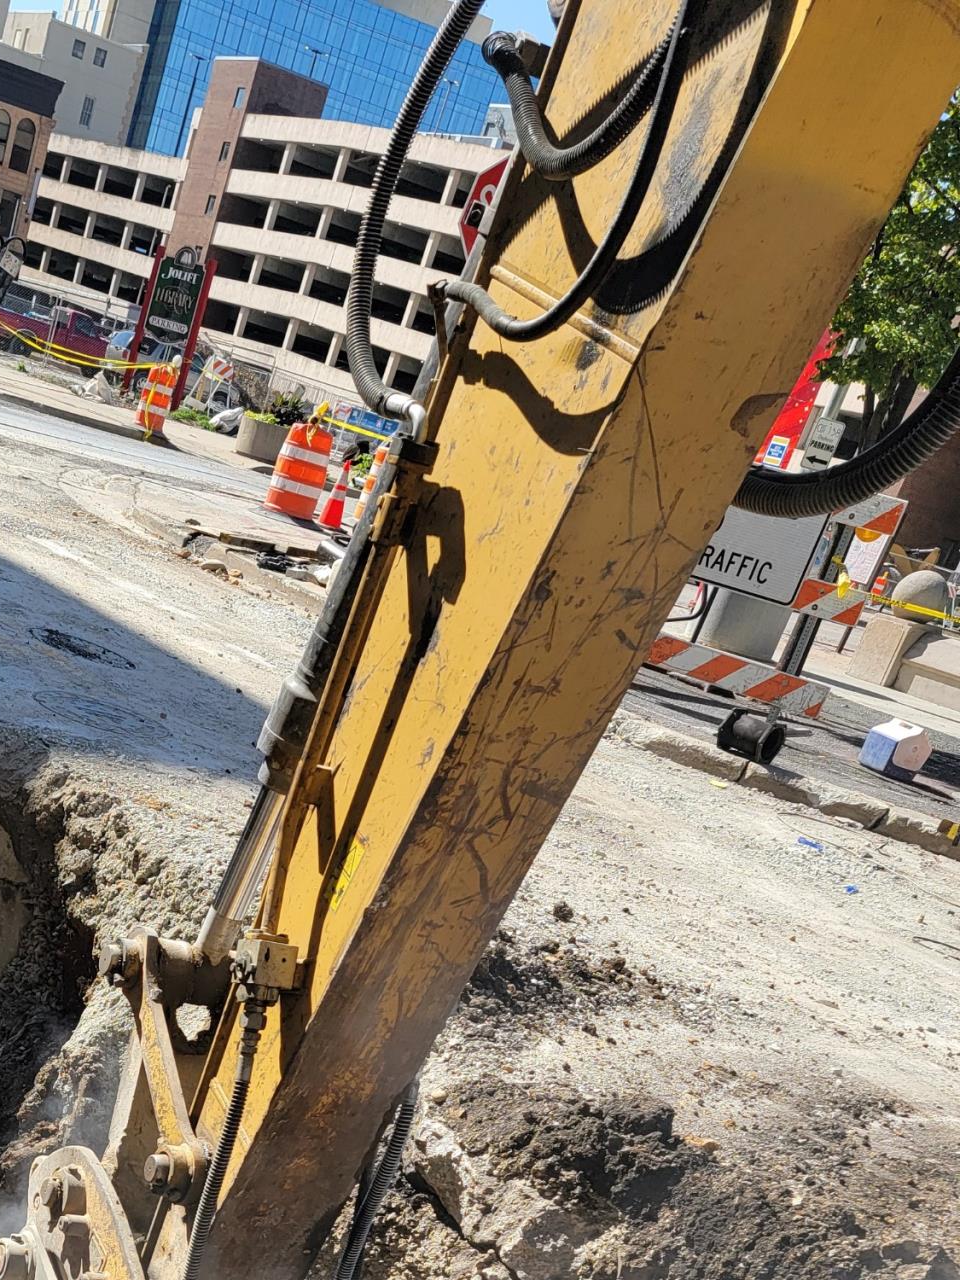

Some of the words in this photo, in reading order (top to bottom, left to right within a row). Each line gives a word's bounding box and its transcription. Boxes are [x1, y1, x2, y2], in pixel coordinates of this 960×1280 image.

[161, 267, 200, 285] JOLIET
[156, 287, 195, 314] LIBRARY
[151, 317, 186, 334] PARKING
[809, 439, 835, 454] PARKING
[698, 544, 773, 584] RAFFIC
